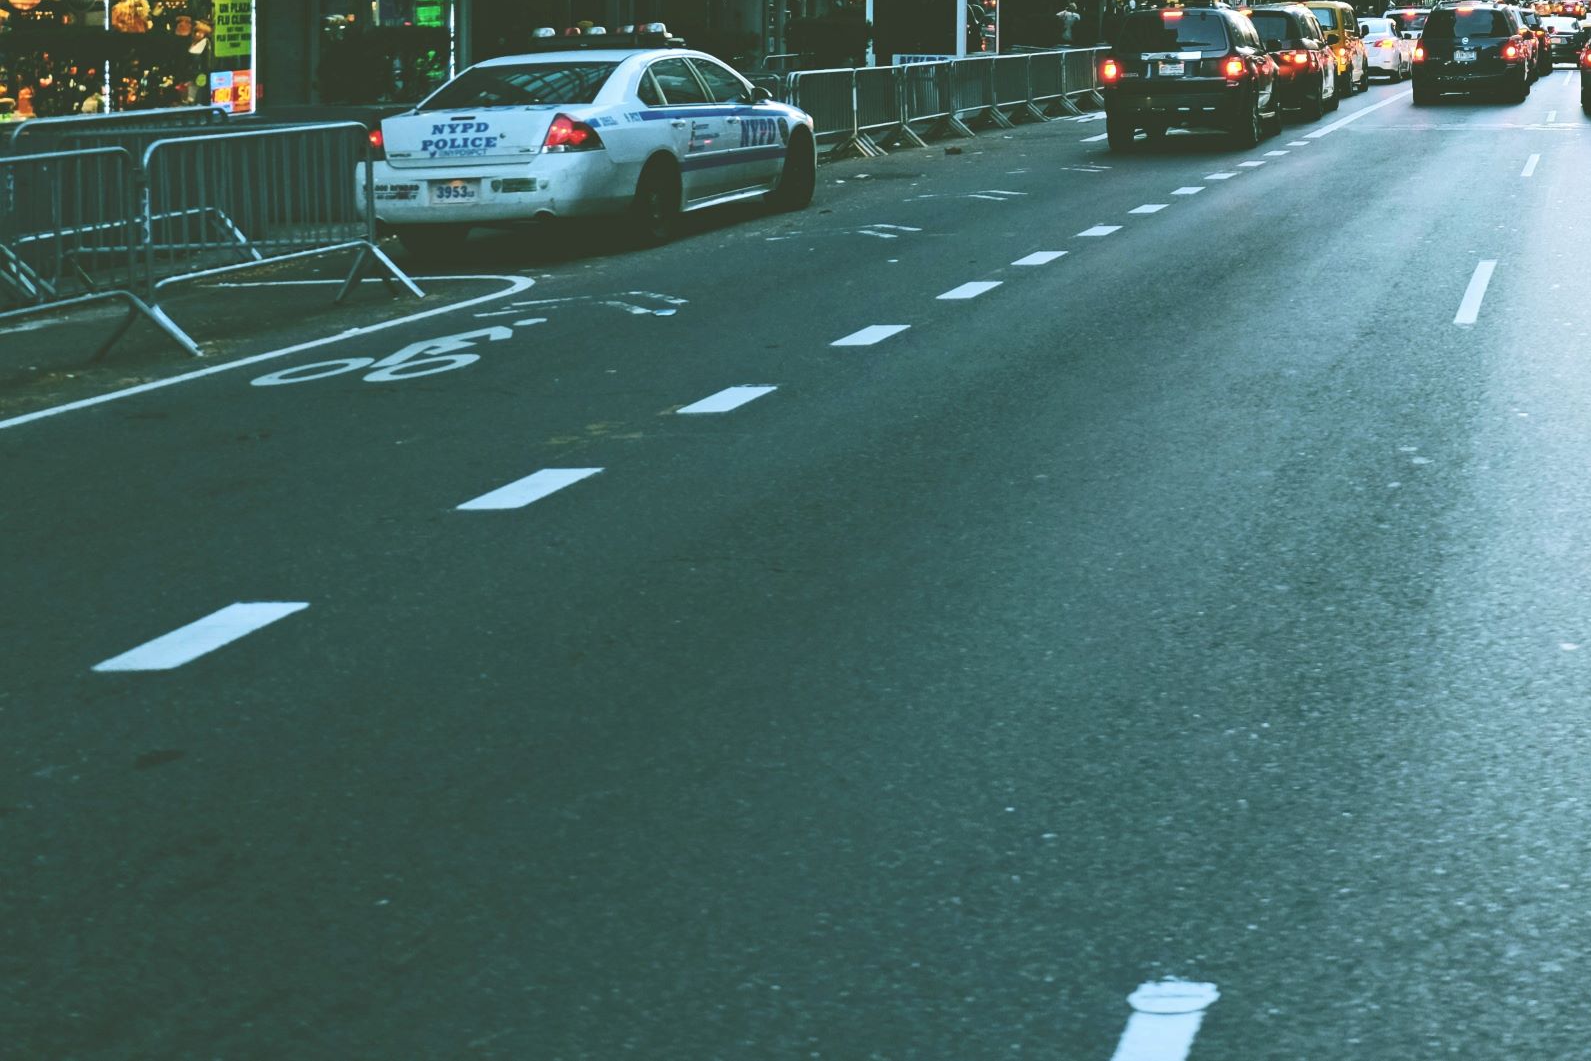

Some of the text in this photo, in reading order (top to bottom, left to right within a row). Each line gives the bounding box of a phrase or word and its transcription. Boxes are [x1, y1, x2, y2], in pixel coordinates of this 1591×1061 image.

[432, 122, 489, 135] NYPD
[740, 118, 777, 147] NYPD
[421, 136, 498, 151] POLICE
[436, 185, 468, 199] 3953
